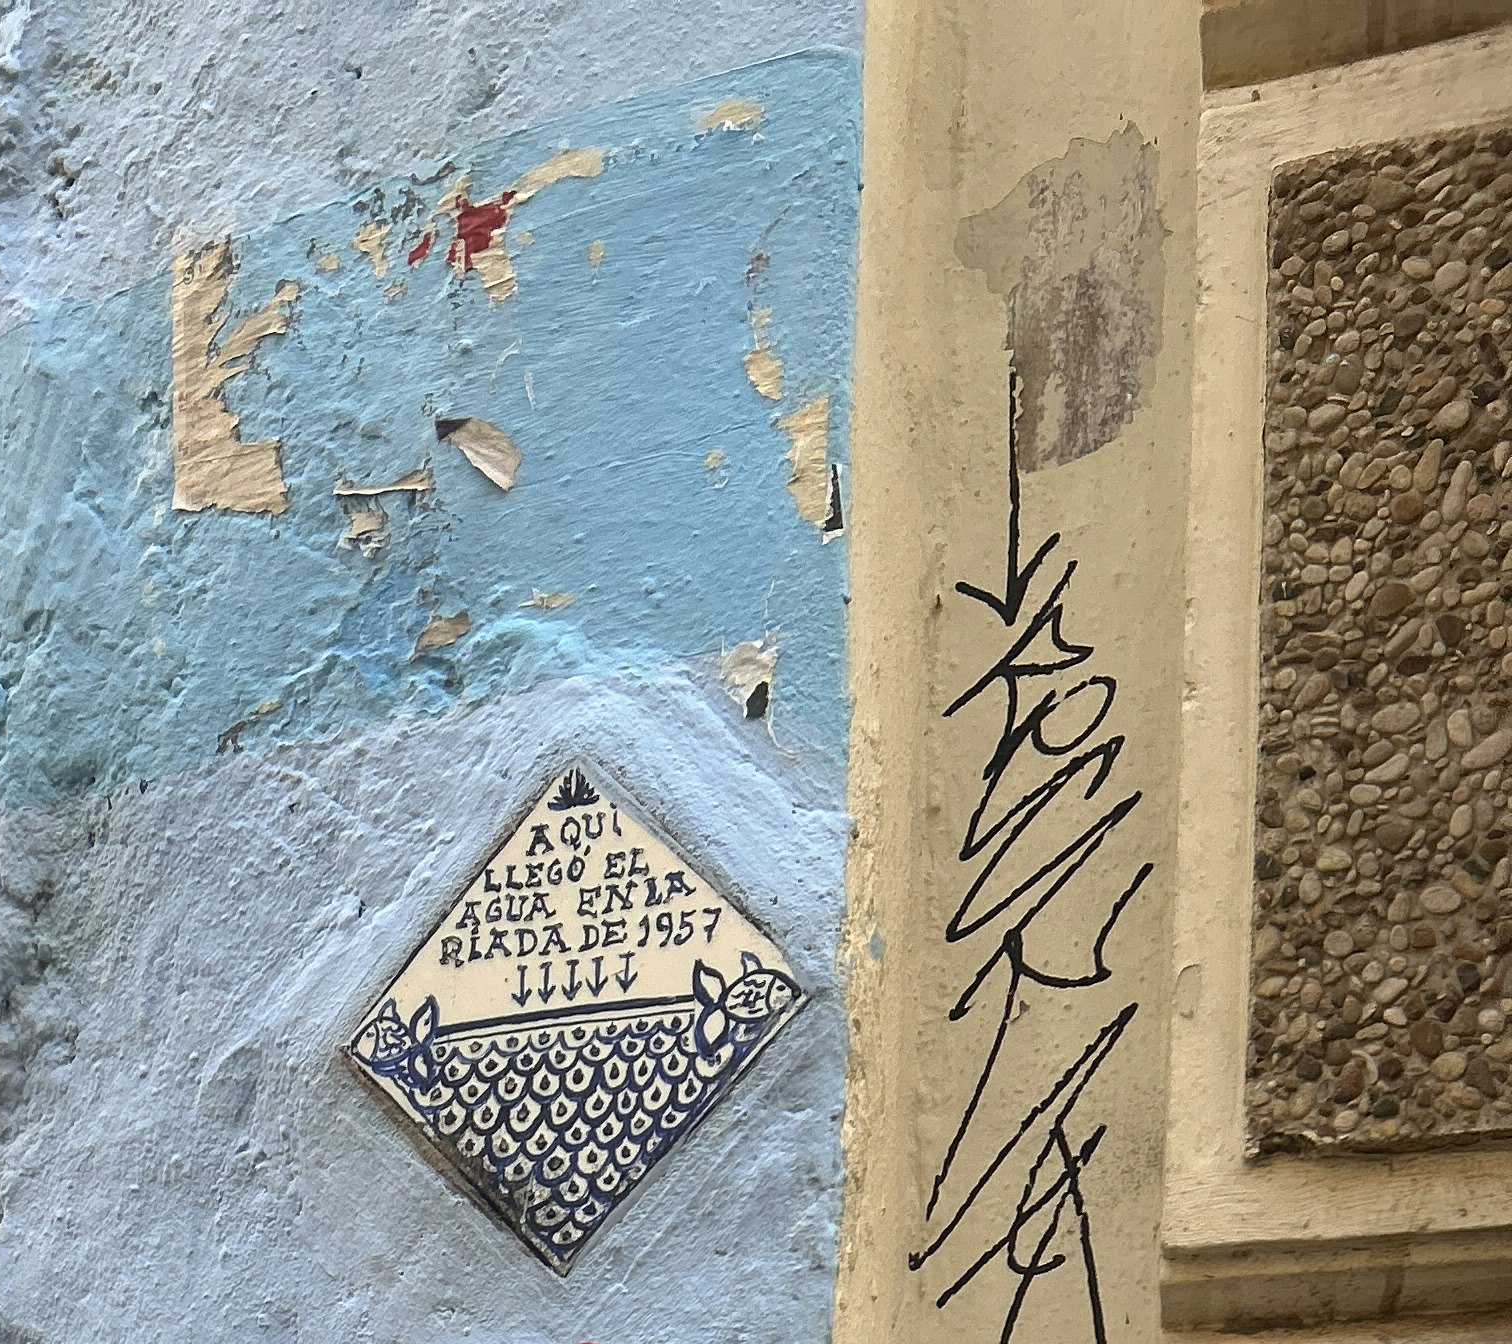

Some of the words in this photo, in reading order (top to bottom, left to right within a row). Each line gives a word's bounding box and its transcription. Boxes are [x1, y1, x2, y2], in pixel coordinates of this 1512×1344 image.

[604, 848, 649, 879] EL
[456, 892, 556, 929] AGUA
[578, 919, 628, 952] DE
[637, 907, 722, 948] 1957
